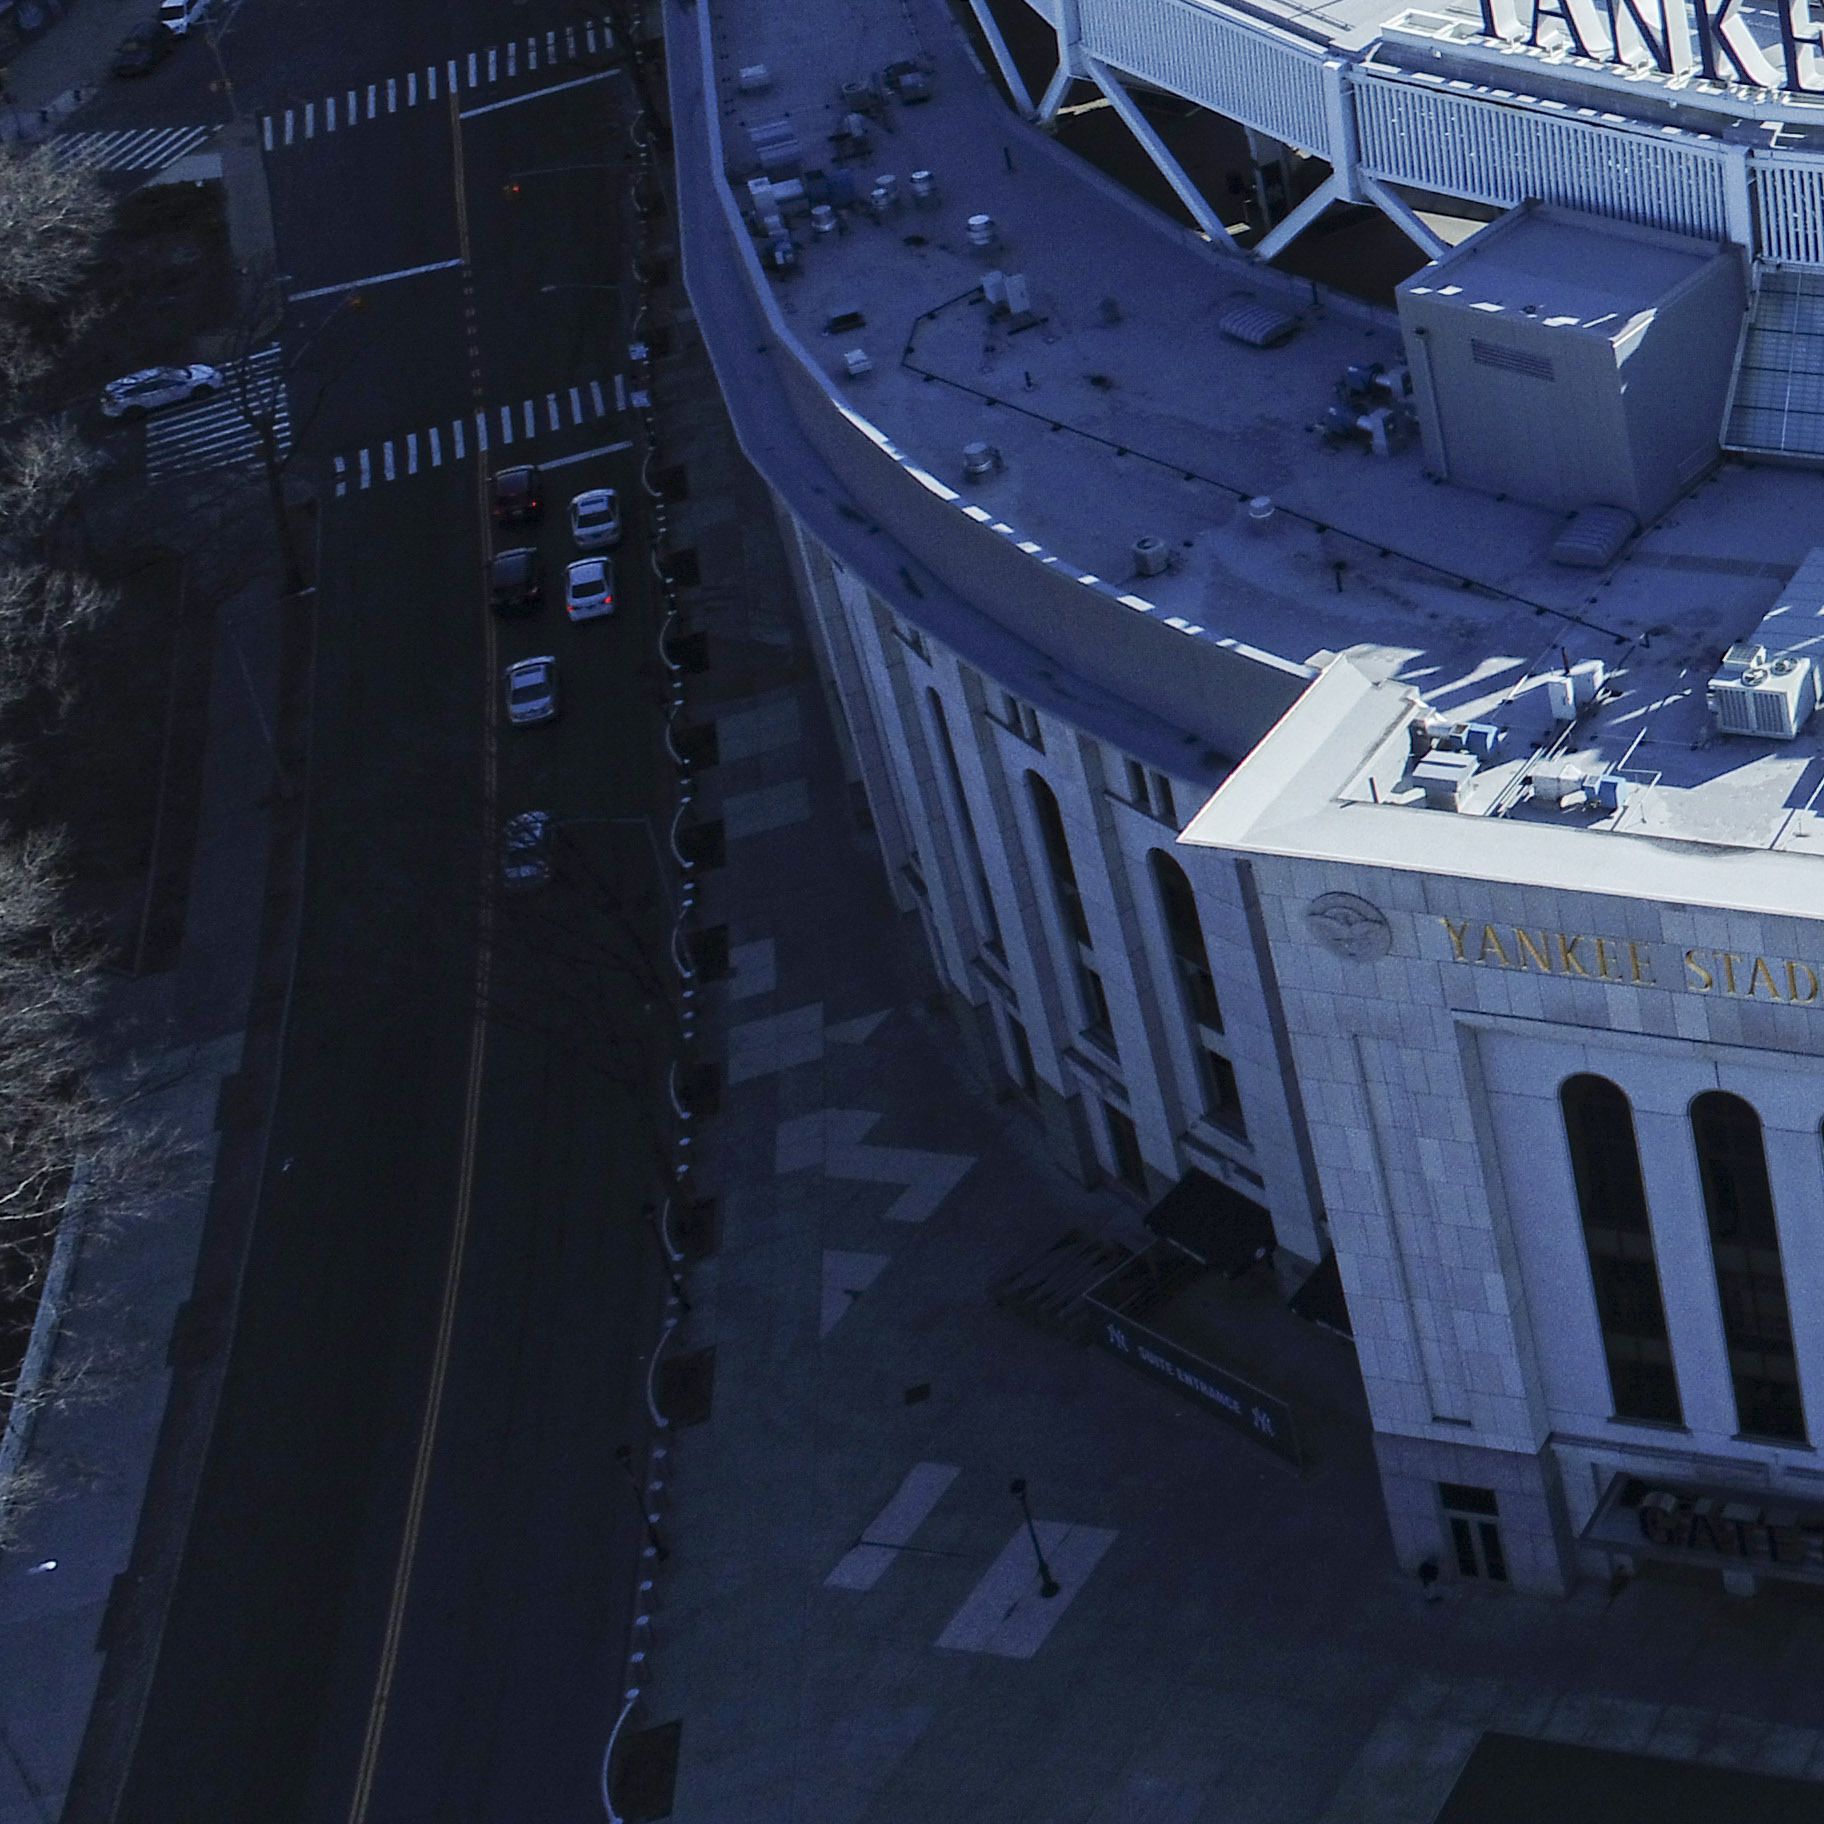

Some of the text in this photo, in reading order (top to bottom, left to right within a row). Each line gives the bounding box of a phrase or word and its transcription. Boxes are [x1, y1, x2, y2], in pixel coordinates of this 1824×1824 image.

[1439, 916, 1659, 988] YANKEE
[1137, 1344, 1243, 1416] SUITE ENTRANCE
